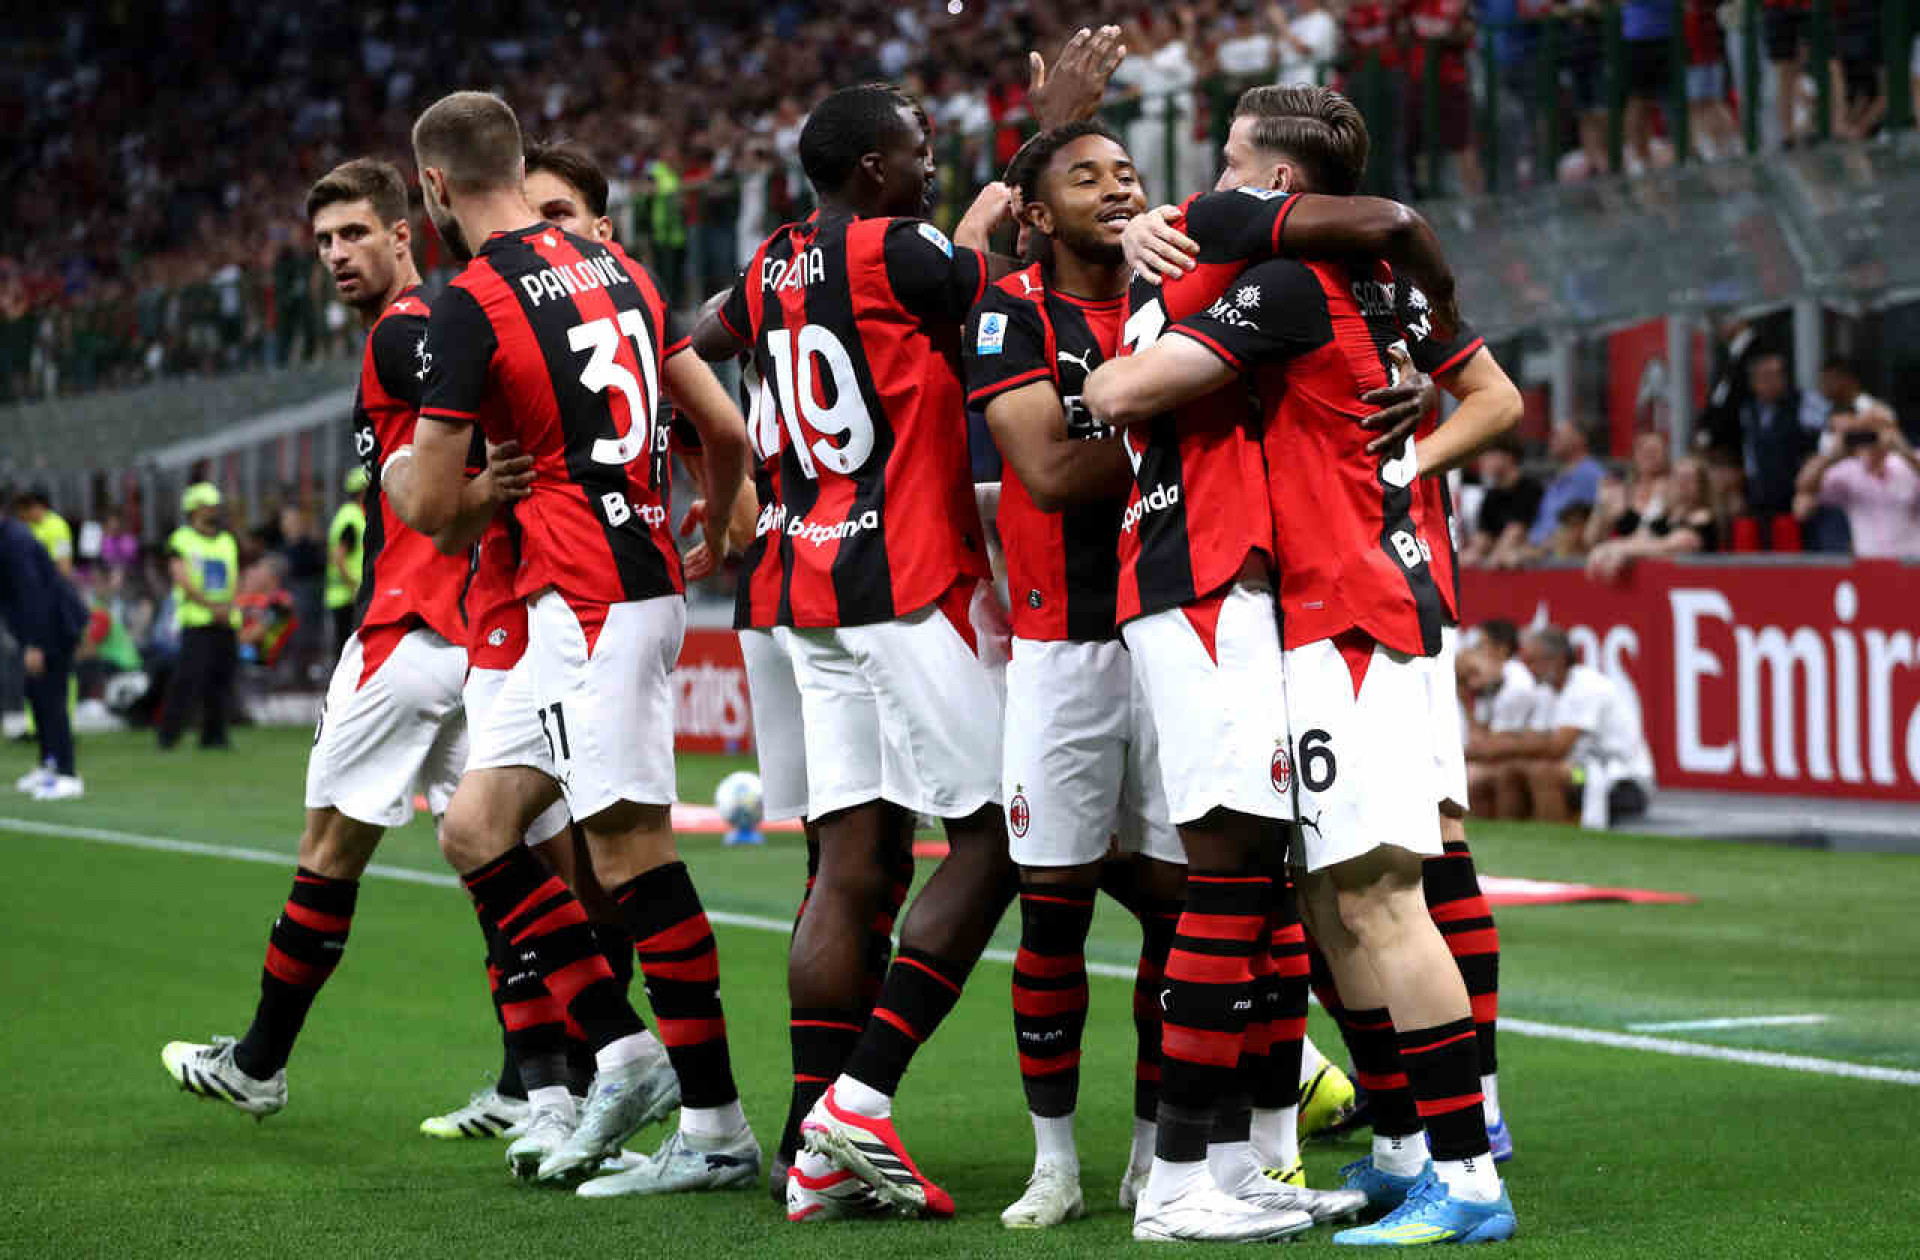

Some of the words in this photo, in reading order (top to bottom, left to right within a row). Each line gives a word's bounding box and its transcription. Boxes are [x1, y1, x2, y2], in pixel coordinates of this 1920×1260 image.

[520, 249, 629, 307] PAVLOVIĆ
[761, 248, 826, 292] FOANA
[566, 308, 659, 466] 31
[767, 323, 876, 480] 19
